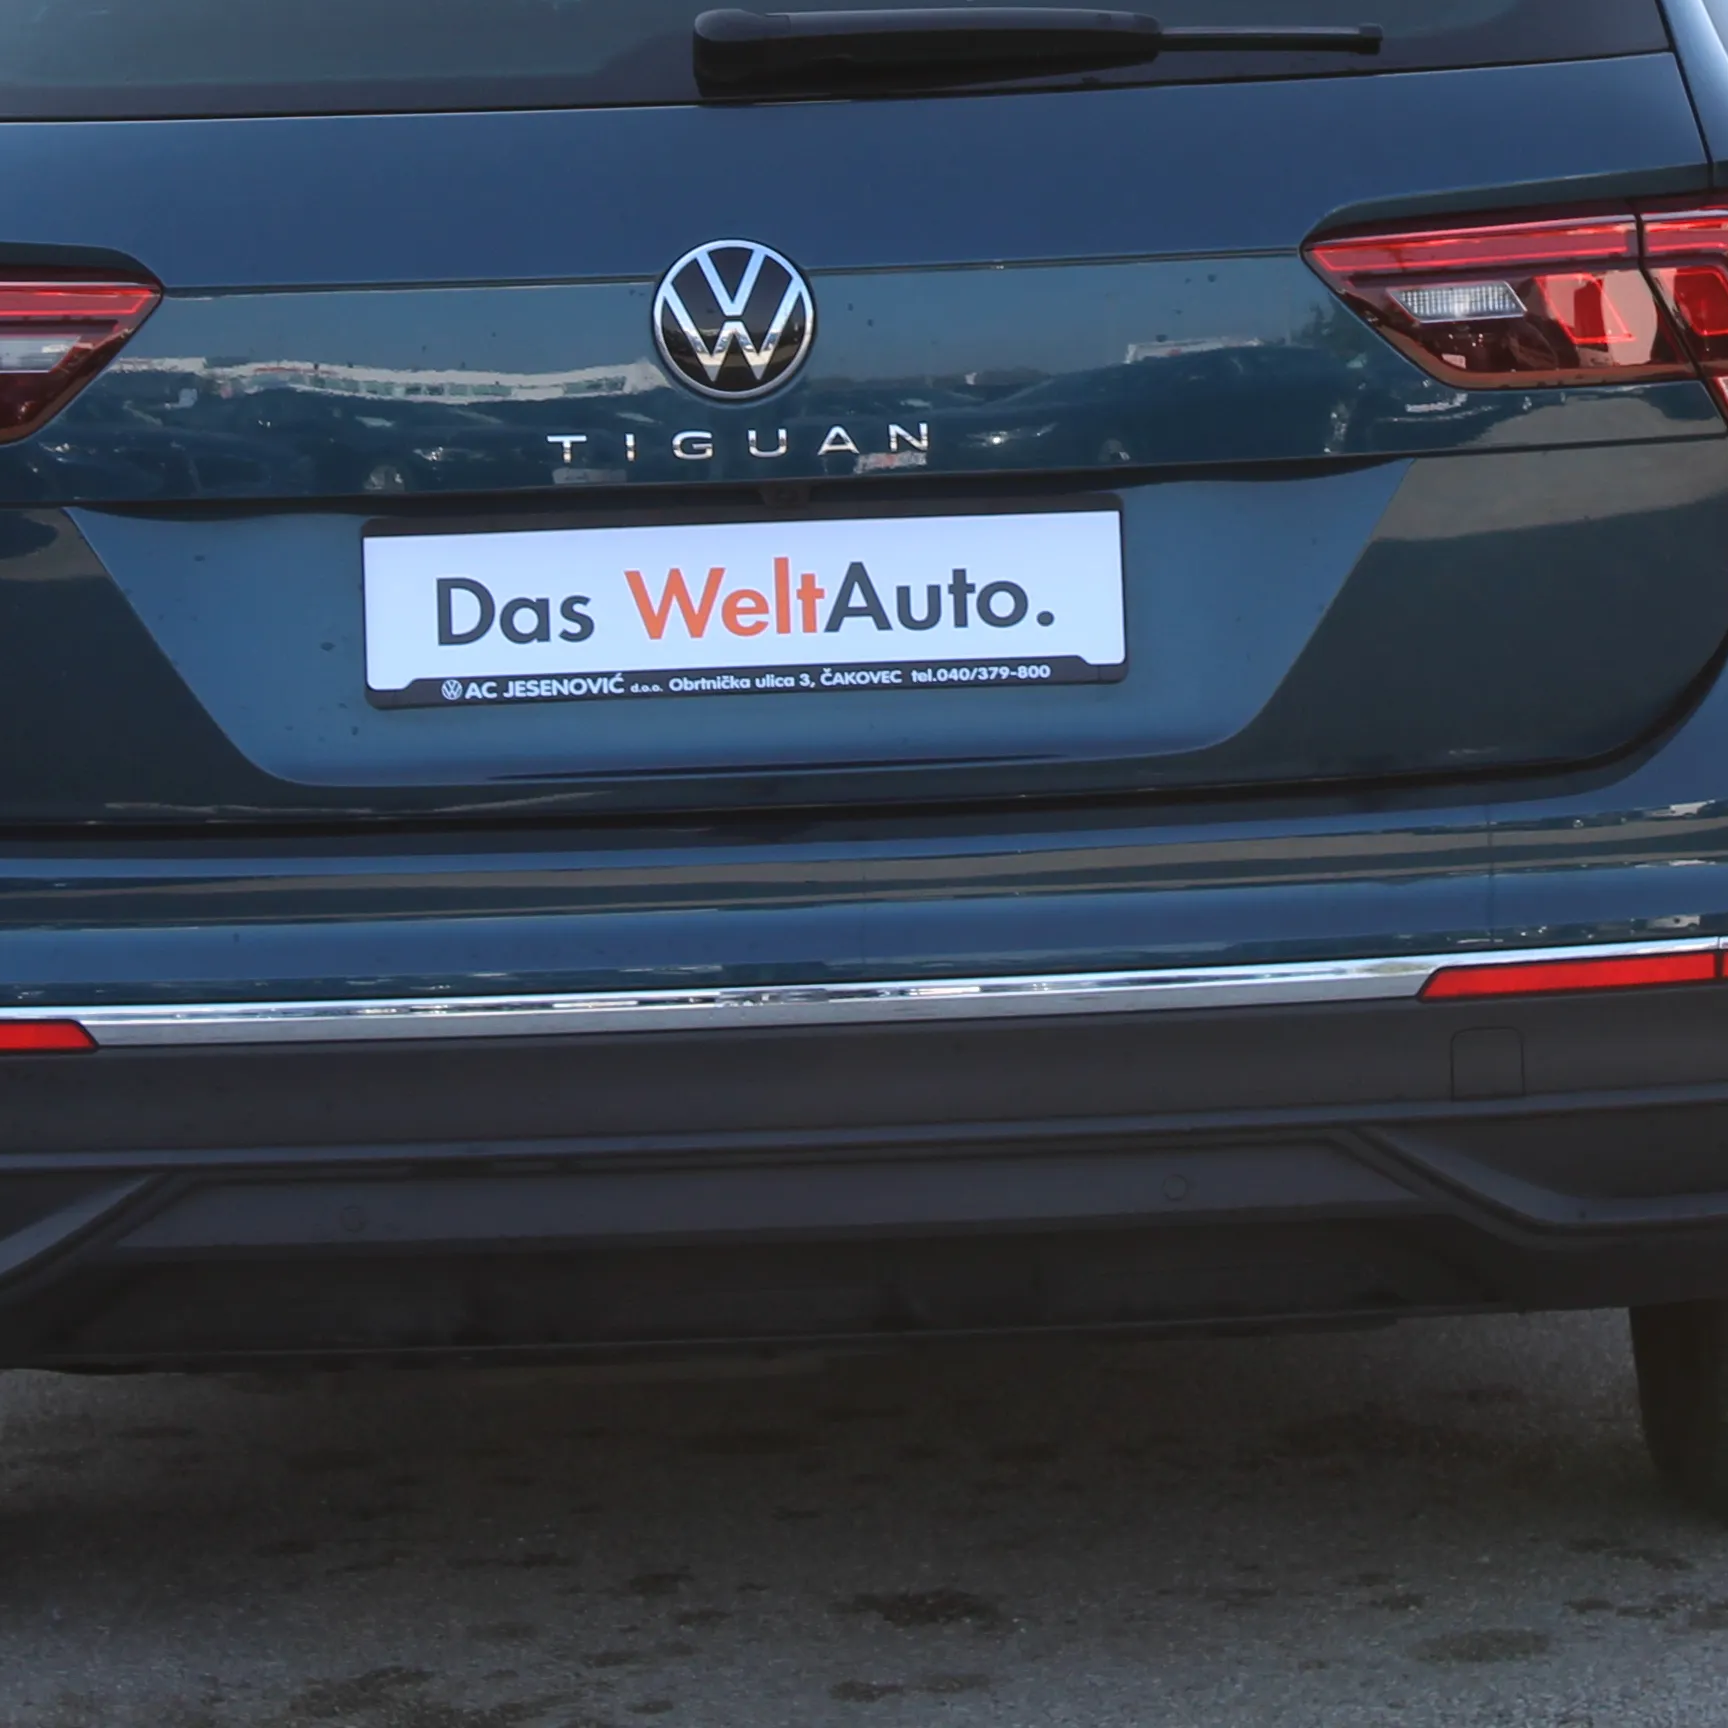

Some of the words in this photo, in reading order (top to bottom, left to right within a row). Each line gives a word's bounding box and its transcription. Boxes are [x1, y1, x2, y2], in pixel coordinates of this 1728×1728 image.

[546, 422, 929, 463] TIGUAN
[435, 576, 595, 647] Das
[625, 557, 1056, 640] WeltAuto.
[464, 681, 498, 700] AC
[503, 672, 625, 699] JESENOVIĆ
[630, 682, 663, 694] d.o.o.
[668, 674, 751, 692] Obrtnička
[755, 673, 796, 689] ulica
[799, 673, 816, 689] 3,
[820, 668, 903, 686] ČAKOVEC
